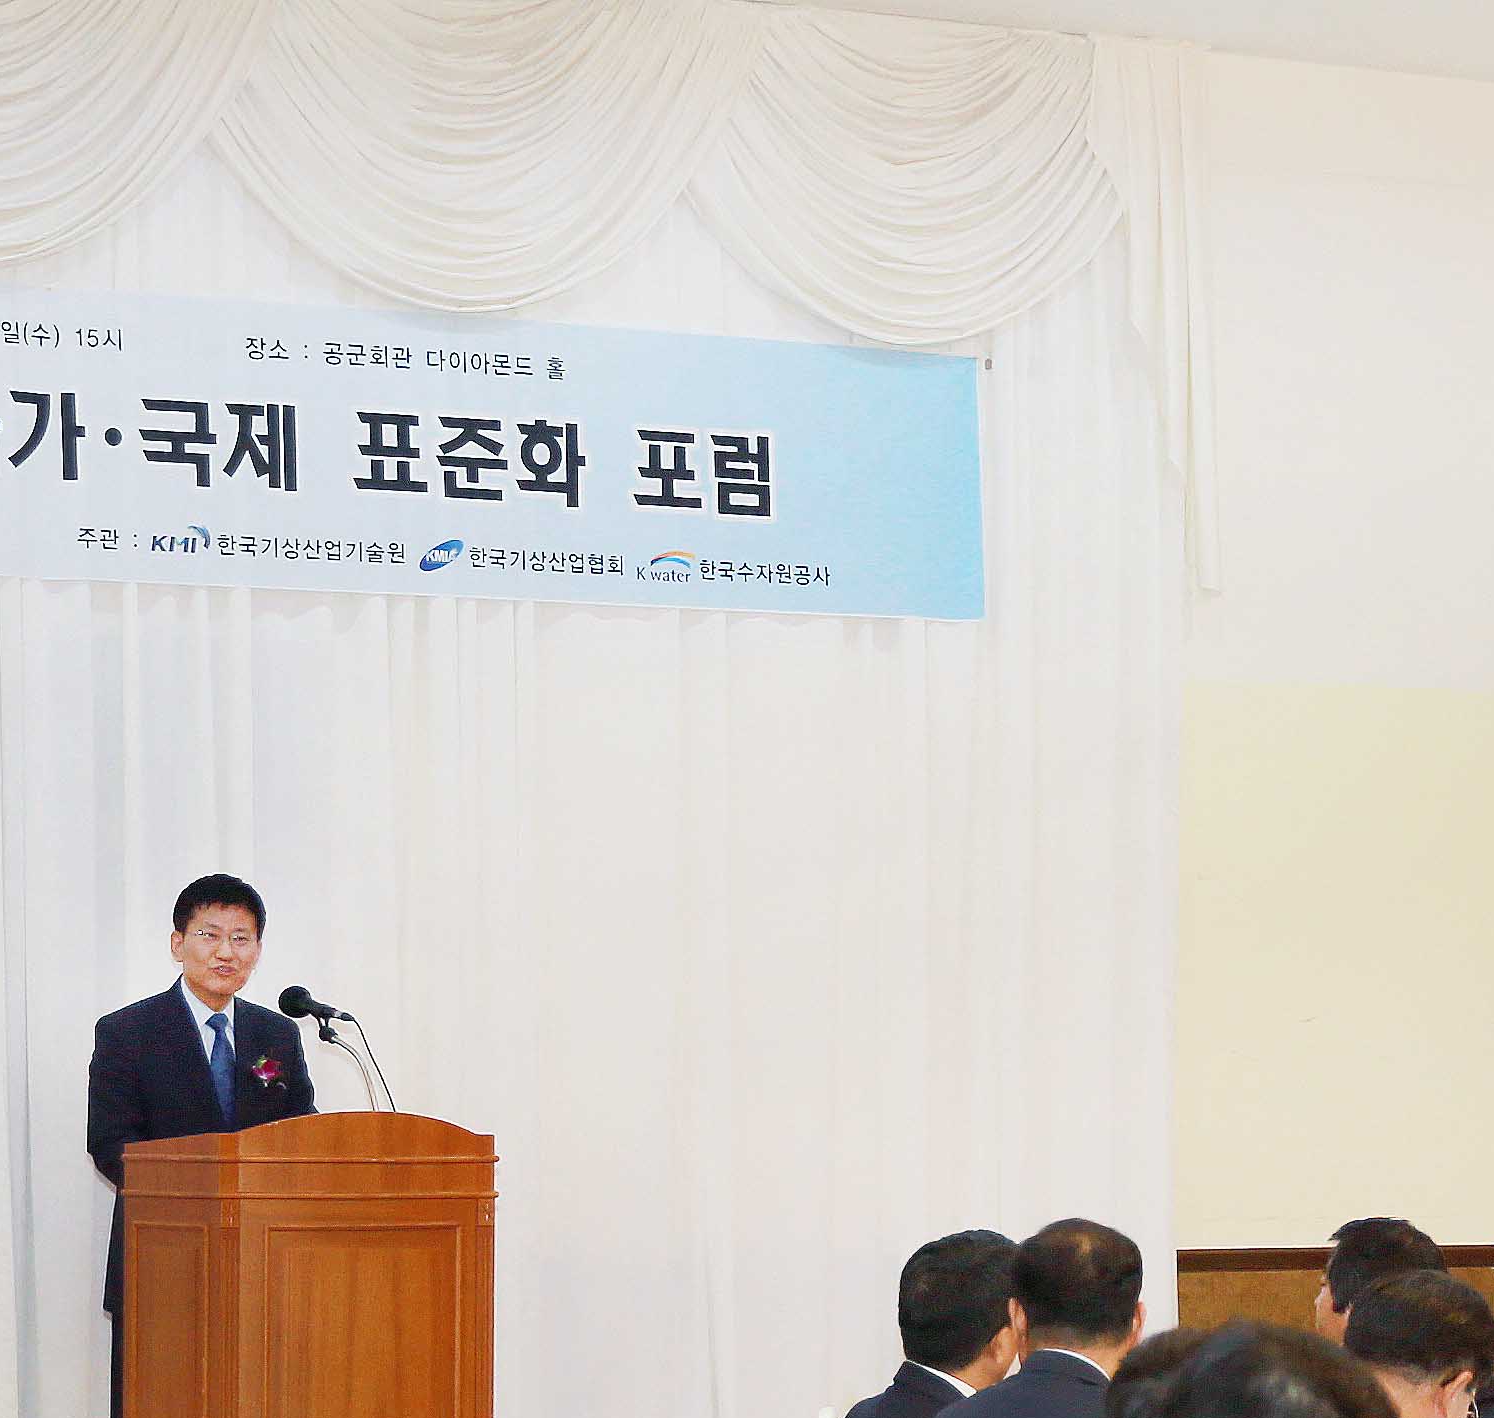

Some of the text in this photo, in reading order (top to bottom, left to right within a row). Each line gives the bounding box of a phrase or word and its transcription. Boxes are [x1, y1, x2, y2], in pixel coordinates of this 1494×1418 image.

[75, 328, 122, 352] 15시
[245, 337, 290, 361] 장소
[322, 342, 413, 370] 공군회관
[426, 349, 534, 376] 다이아몬드
[546, 356, 566, 381] 홀
[352, 411, 587, 508] 표준화
[632, 429, 771, 518] 포럼
[76, 527, 120, 550] 주관
[150, 534, 198, 555] KMI
[216, 534, 406, 564] 한국기상산업기술원
[469, 546, 624, 577] 한국기상산업협회
[649, 568, 692, 584] water
[699, 559, 831, 587] 한국수자원공사
